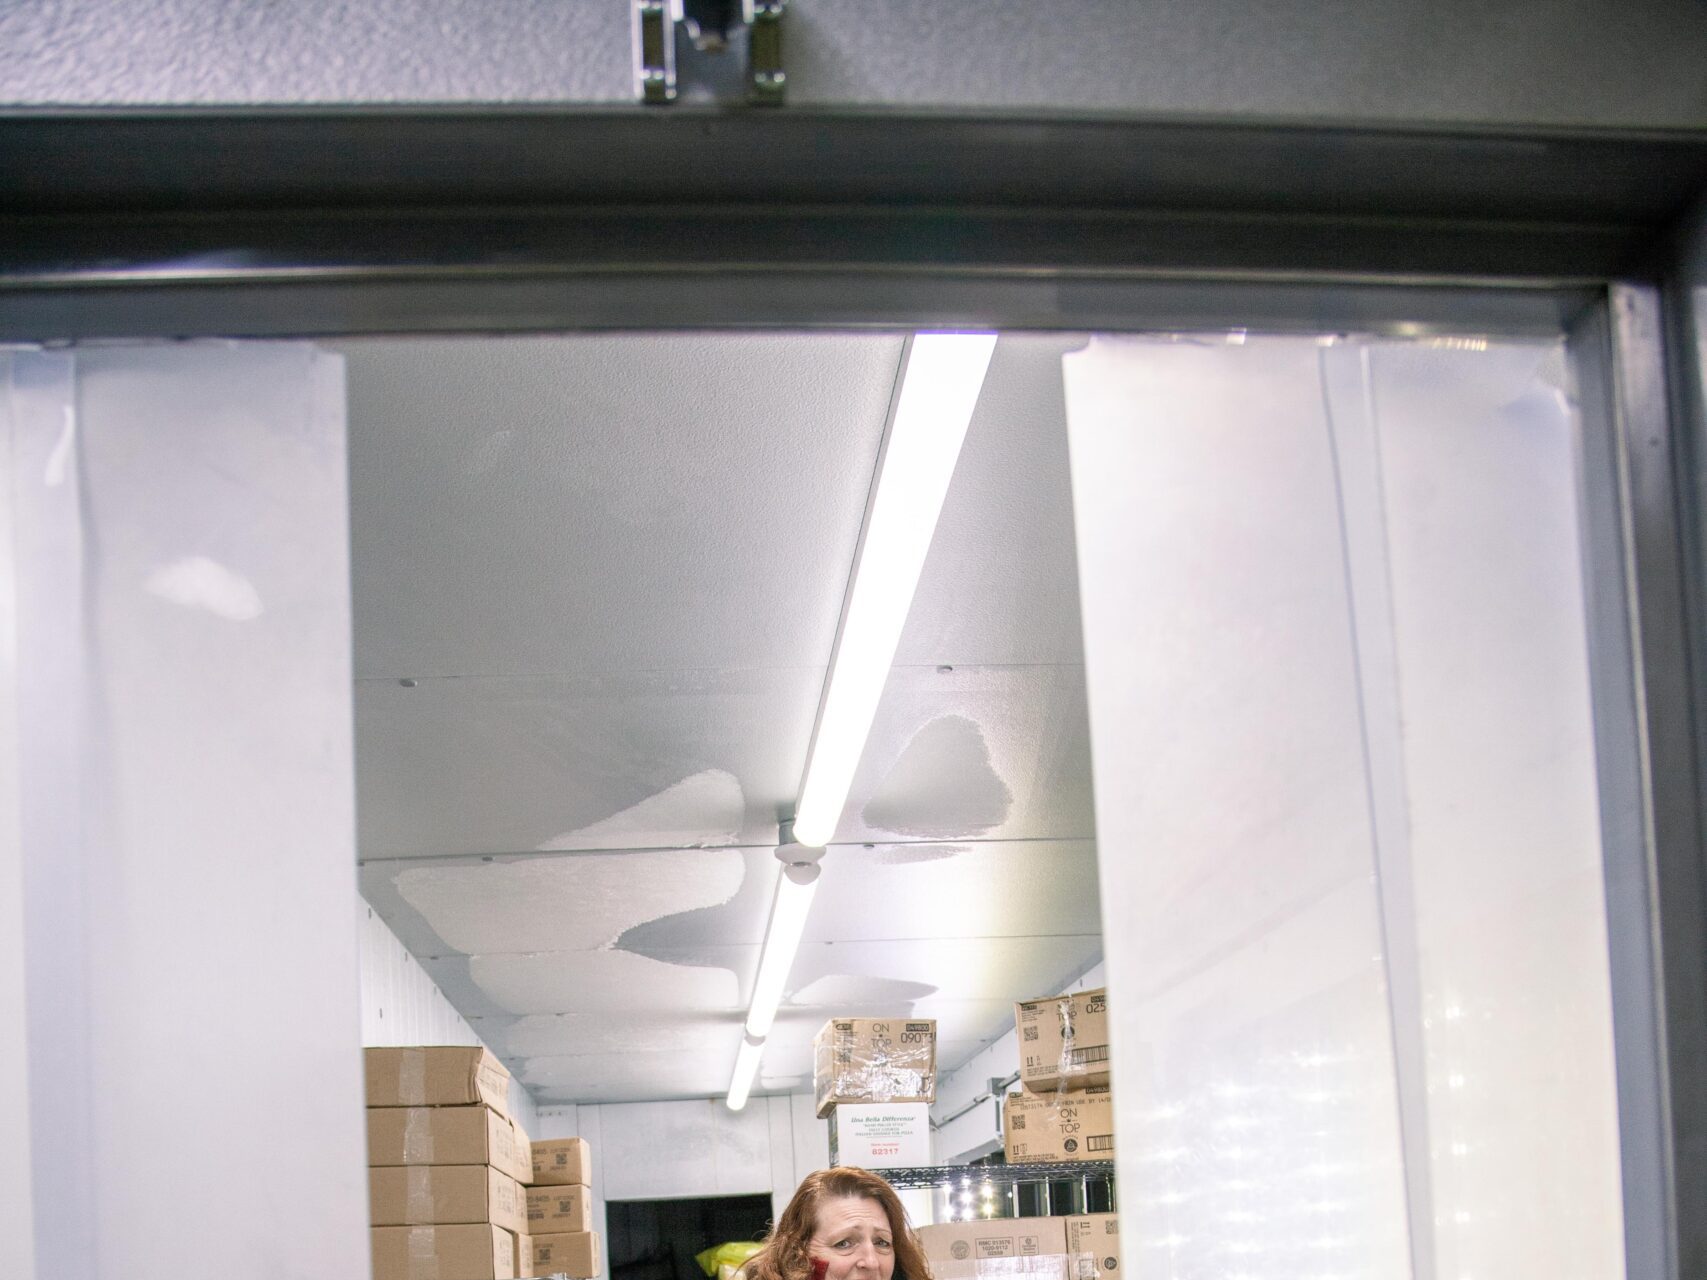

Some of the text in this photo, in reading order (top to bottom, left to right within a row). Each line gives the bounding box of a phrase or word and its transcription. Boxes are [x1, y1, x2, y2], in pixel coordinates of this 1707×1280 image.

[872, 1023, 890, 1033] ON
[871, 1038, 892, 1049] TOP
[1060, 1108, 1078, 1118] ON
[1059, 1123, 1080, 1133] TOP
